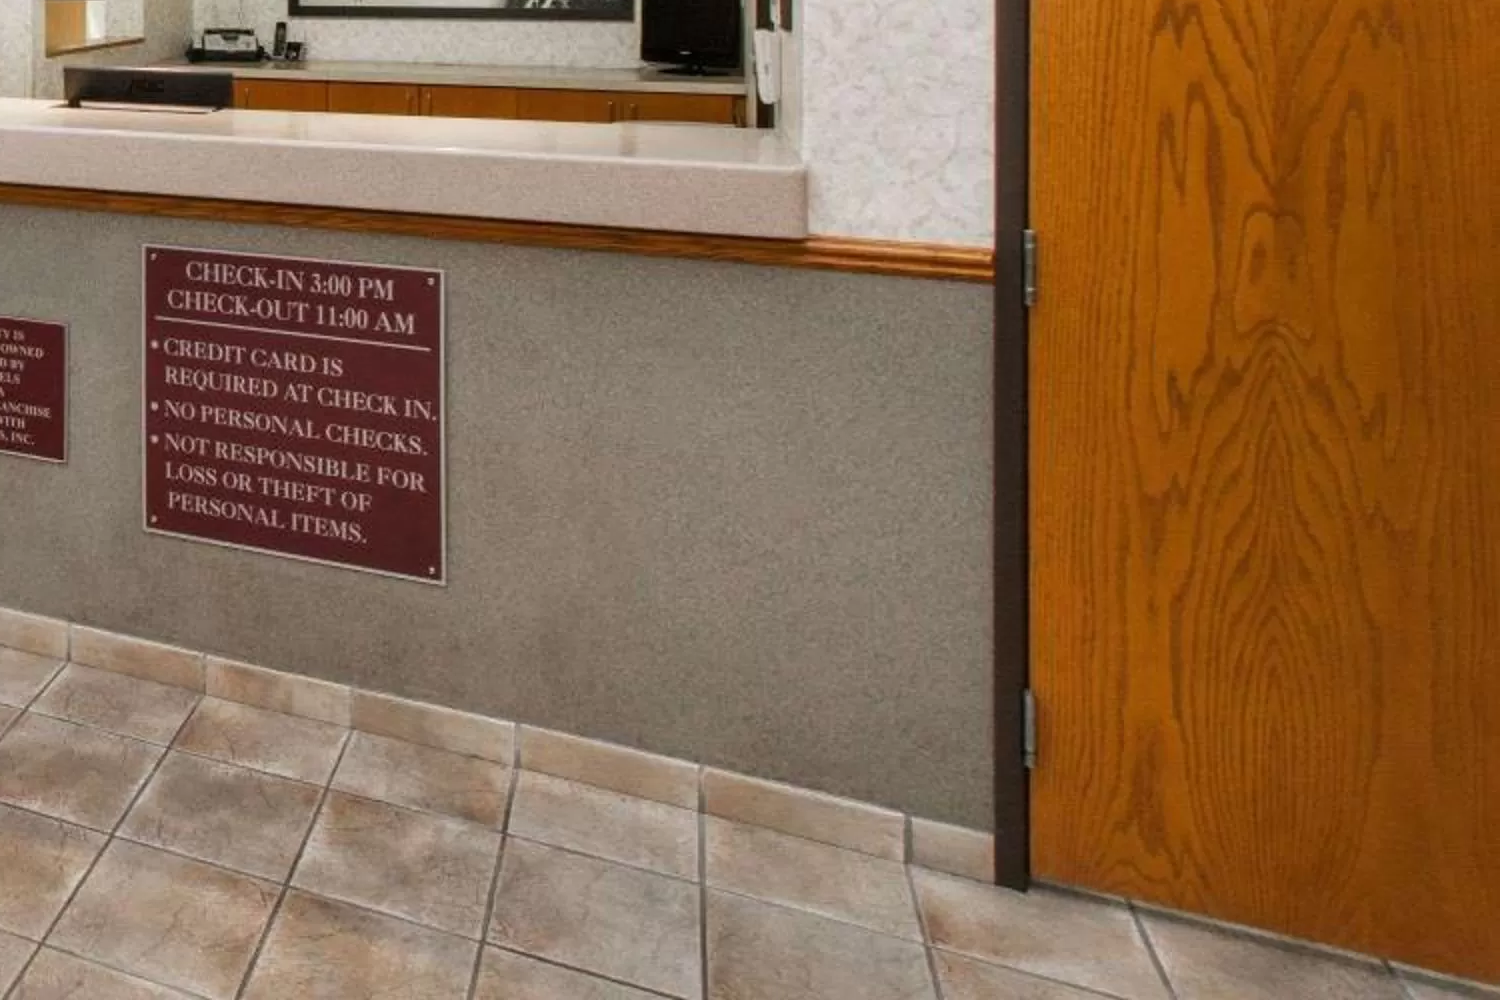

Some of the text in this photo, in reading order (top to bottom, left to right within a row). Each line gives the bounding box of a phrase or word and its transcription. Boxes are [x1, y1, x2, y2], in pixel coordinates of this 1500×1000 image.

[185, 260, 395, 301] CHECK-IN 3:00 PM
[167, 289, 416, 335] CHECK-OUT 11:00 AM
[0, 344, 45, 360] OWNED
[13, 329, 25, 341] IS
[10, 359, 25, 371] BY
[163, 338, 344, 377] CREDIT CARD IS
[164, 365, 437, 421] REQUIRED AT CHECK IN.
[11, 431, 35, 446] INC.
[163, 400, 429, 456] NO PERSONAL CHECKS.
[164, 433, 427, 493] NOT RESPONSIBLE FOR
[165, 461, 373, 513] LOSS OR THEFT OF
[168, 491, 368, 544] PERSONAL ITEMS.
